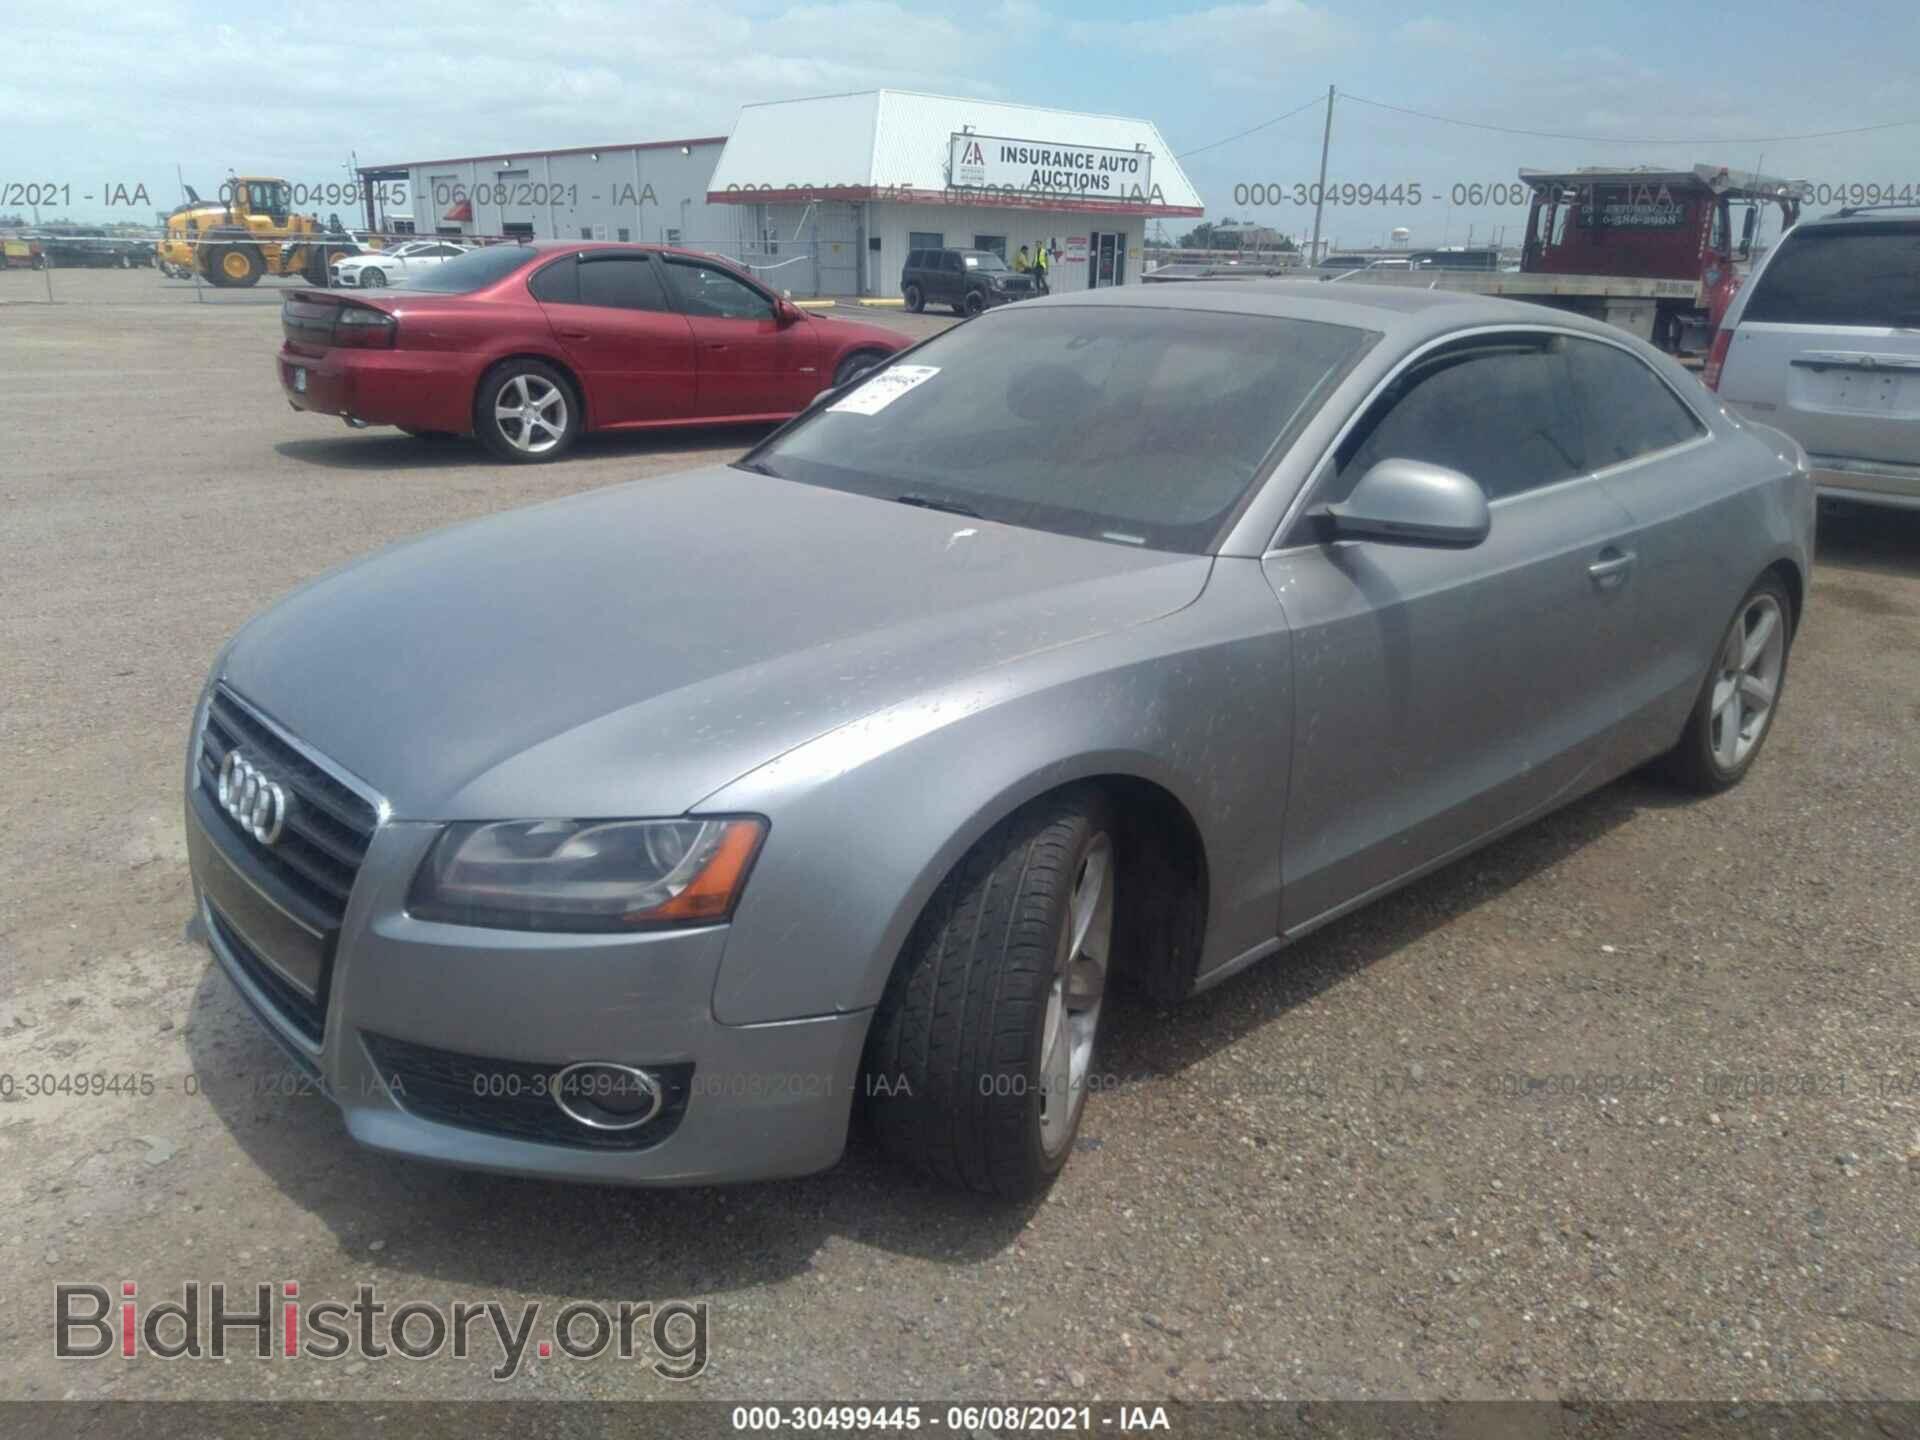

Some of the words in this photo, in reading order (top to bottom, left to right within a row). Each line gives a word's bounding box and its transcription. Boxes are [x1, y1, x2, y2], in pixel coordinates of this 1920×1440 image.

[1000, 146, 1094, 169] INSURANCE
[1099, 156, 1138, 173] AUTO
[1030, 169, 1110, 190] AUCTIONS
